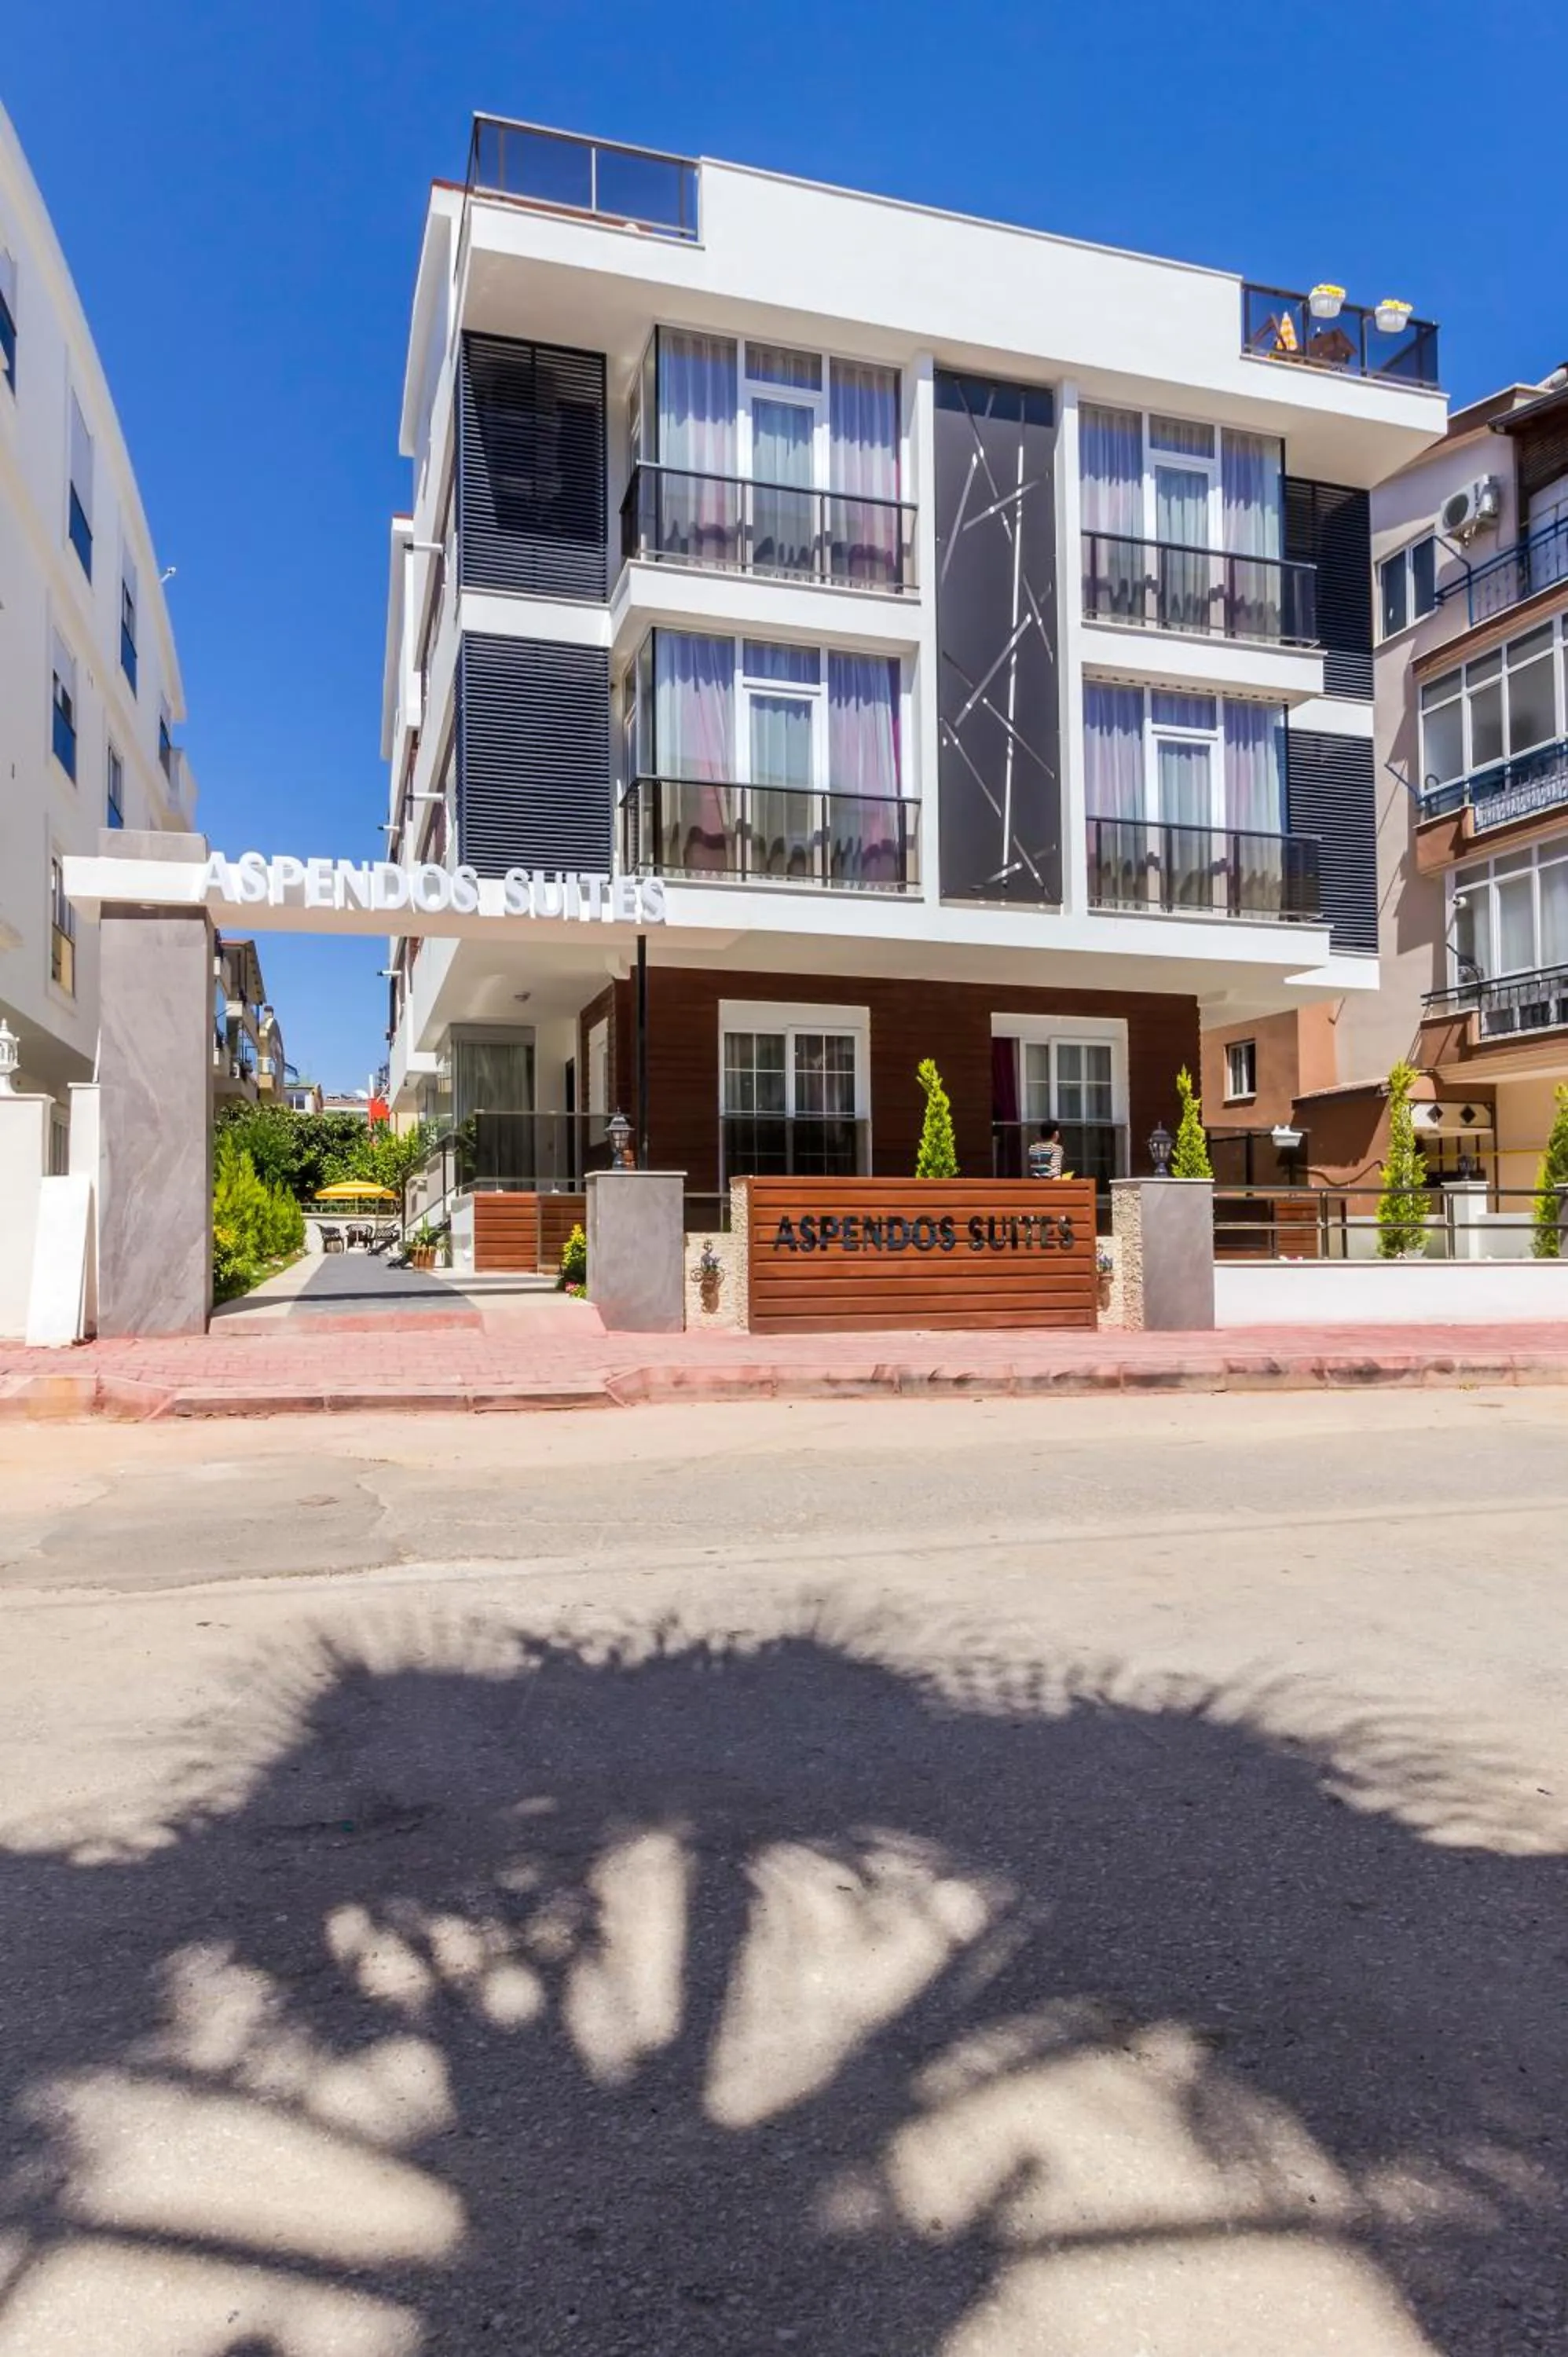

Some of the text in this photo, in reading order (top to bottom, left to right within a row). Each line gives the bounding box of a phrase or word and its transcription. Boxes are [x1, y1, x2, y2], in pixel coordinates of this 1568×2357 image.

[198, 852, 666, 922] ASPENDOS SUITES
[774, 1215, 1075, 1252] ASPENDOS SUITES
